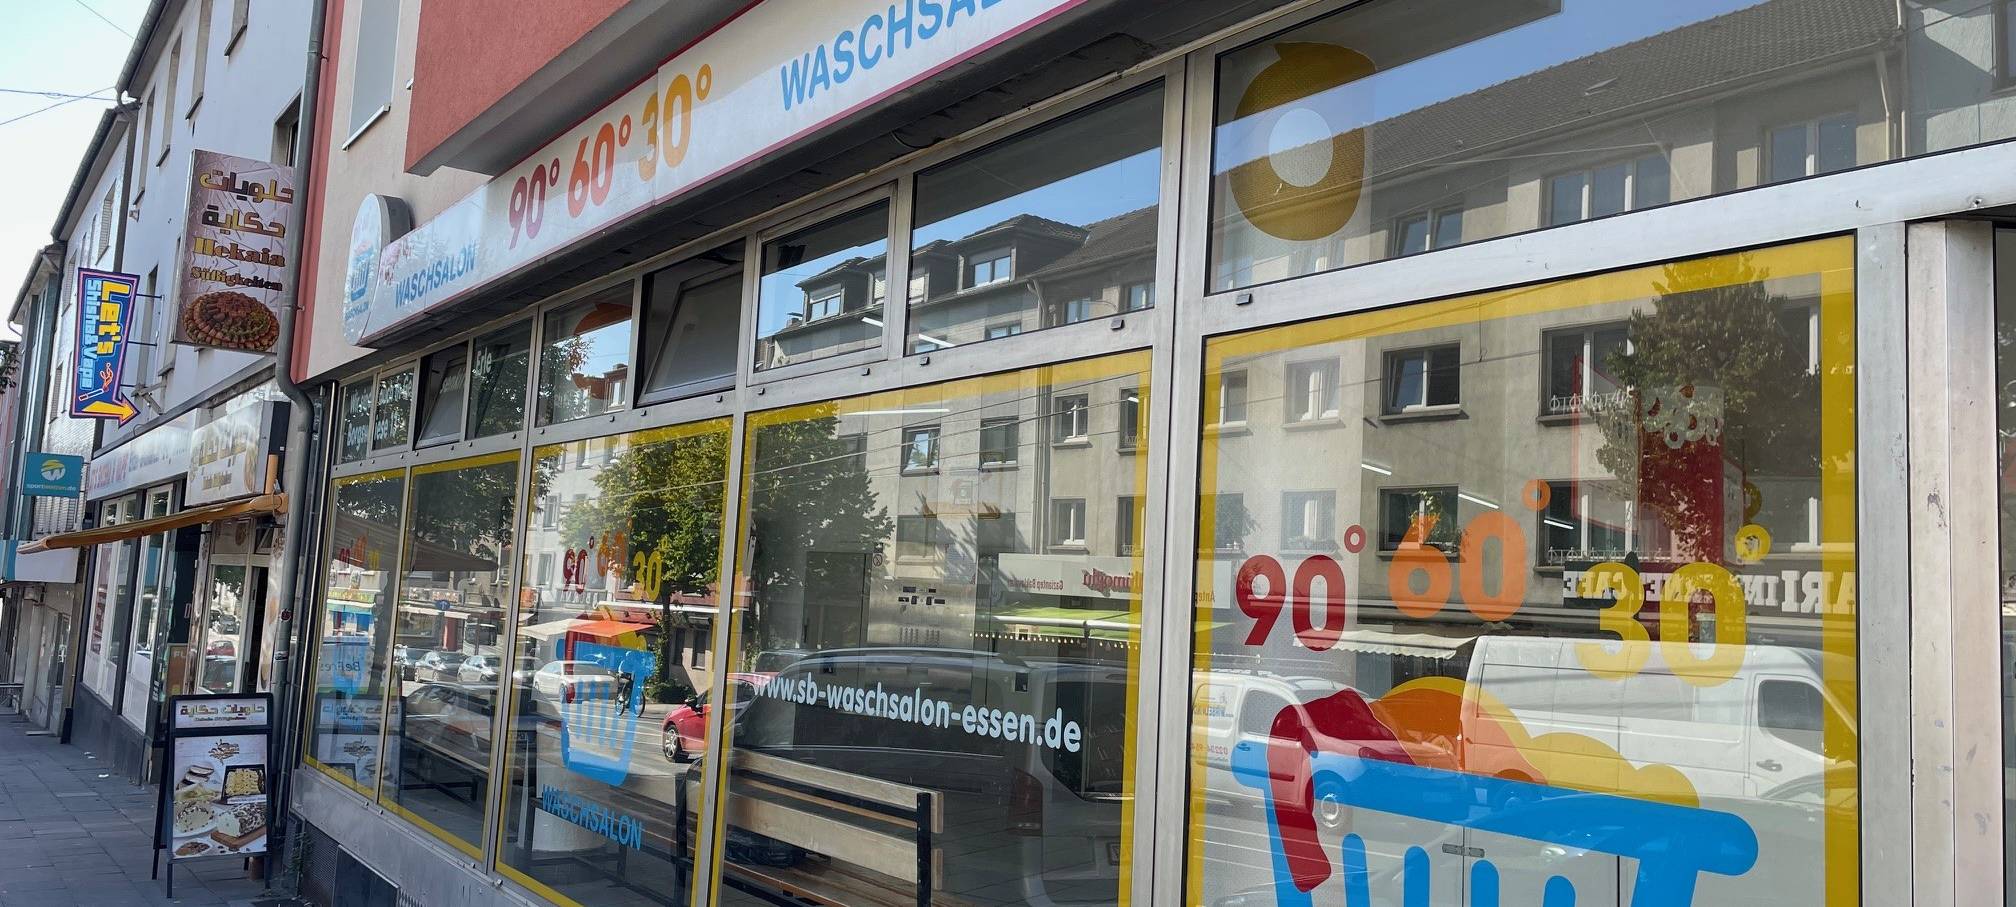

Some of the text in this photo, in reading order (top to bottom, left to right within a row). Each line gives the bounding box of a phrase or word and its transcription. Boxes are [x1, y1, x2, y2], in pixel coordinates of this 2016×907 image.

[780, 0, 1000, 111] WASCHSA
[199, 169, 294, 204] حلويات
[508, 63, 712, 251] 90° 60° 30°
[193, 236, 286, 268] Hekaia
[201, 204, 286, 239] حكاية
[190, 266, 283, 292] Süßigkeiten
[395, 240, 477, 309] WASCHSALON
[97, 280, 131, 355] Let's
[1235, 479, 1771, 688] 90° 60° 30°
[753, 671, 1082, 752] www.sb-waschsalon-essen.de
[542, 784, 642, 851] WASCHSALON
